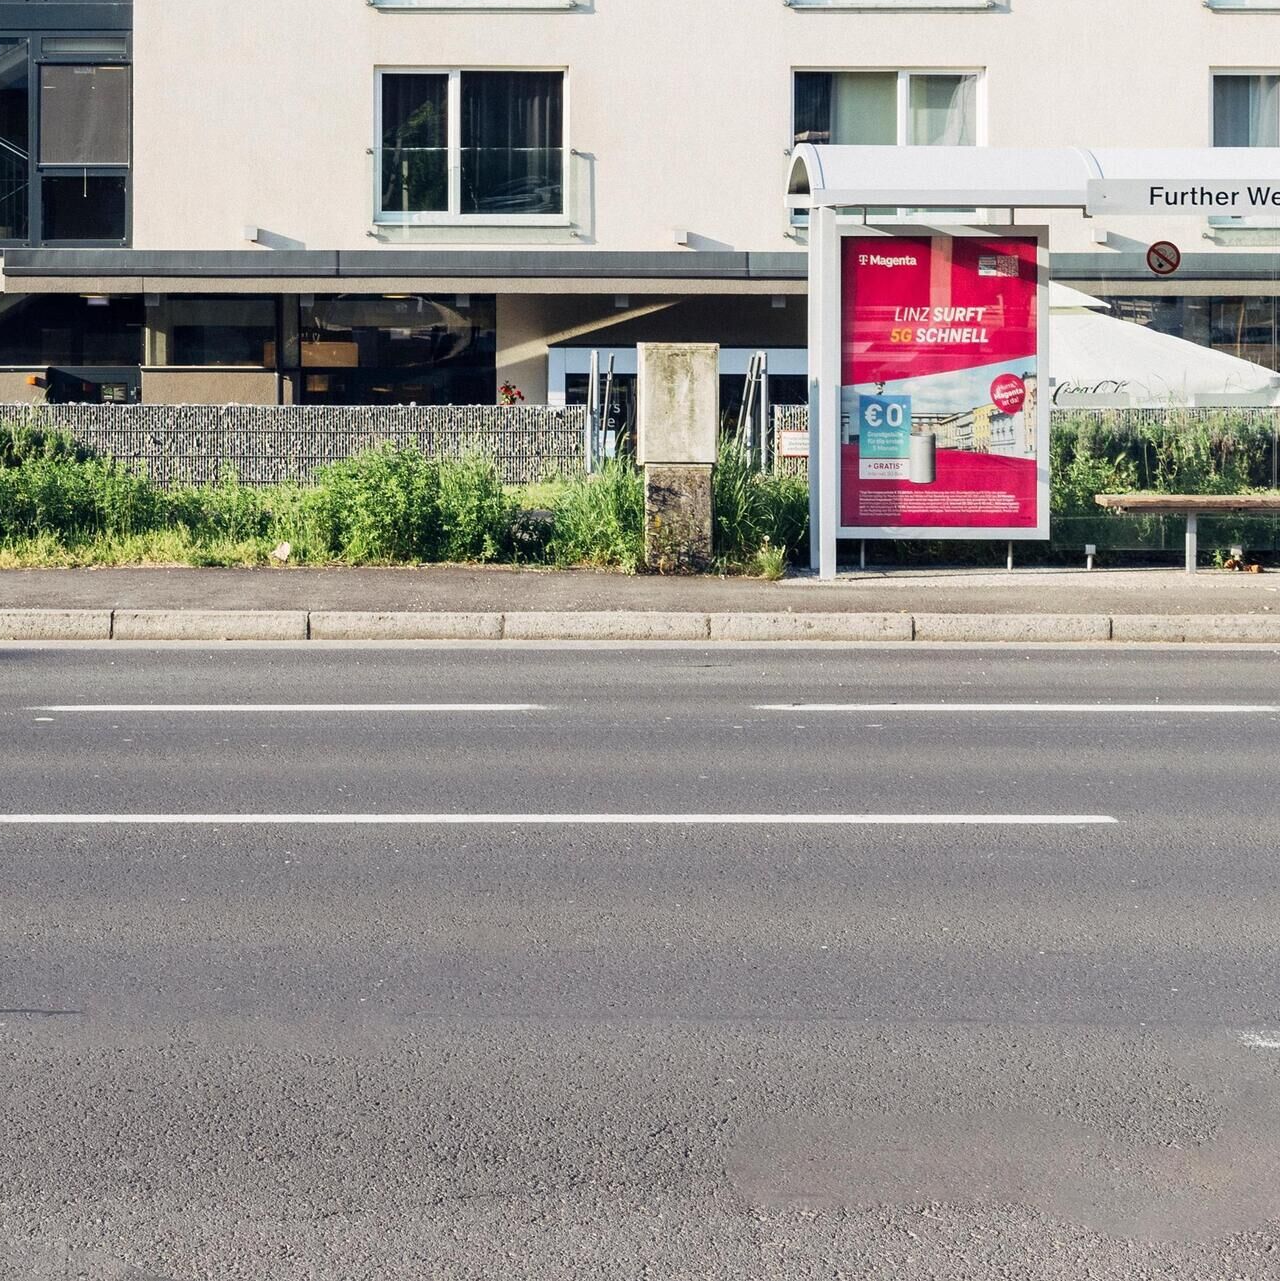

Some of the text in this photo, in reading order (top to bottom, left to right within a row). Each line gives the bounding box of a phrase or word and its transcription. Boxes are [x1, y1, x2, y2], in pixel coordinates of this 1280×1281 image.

[1149, 185, 1240, 207] Further
[870, 254, 918, 268] Magenta
[894, 306, 987, 322] LINZ SURFT
[890, 328, 989, 343] 5G SCHNELL
